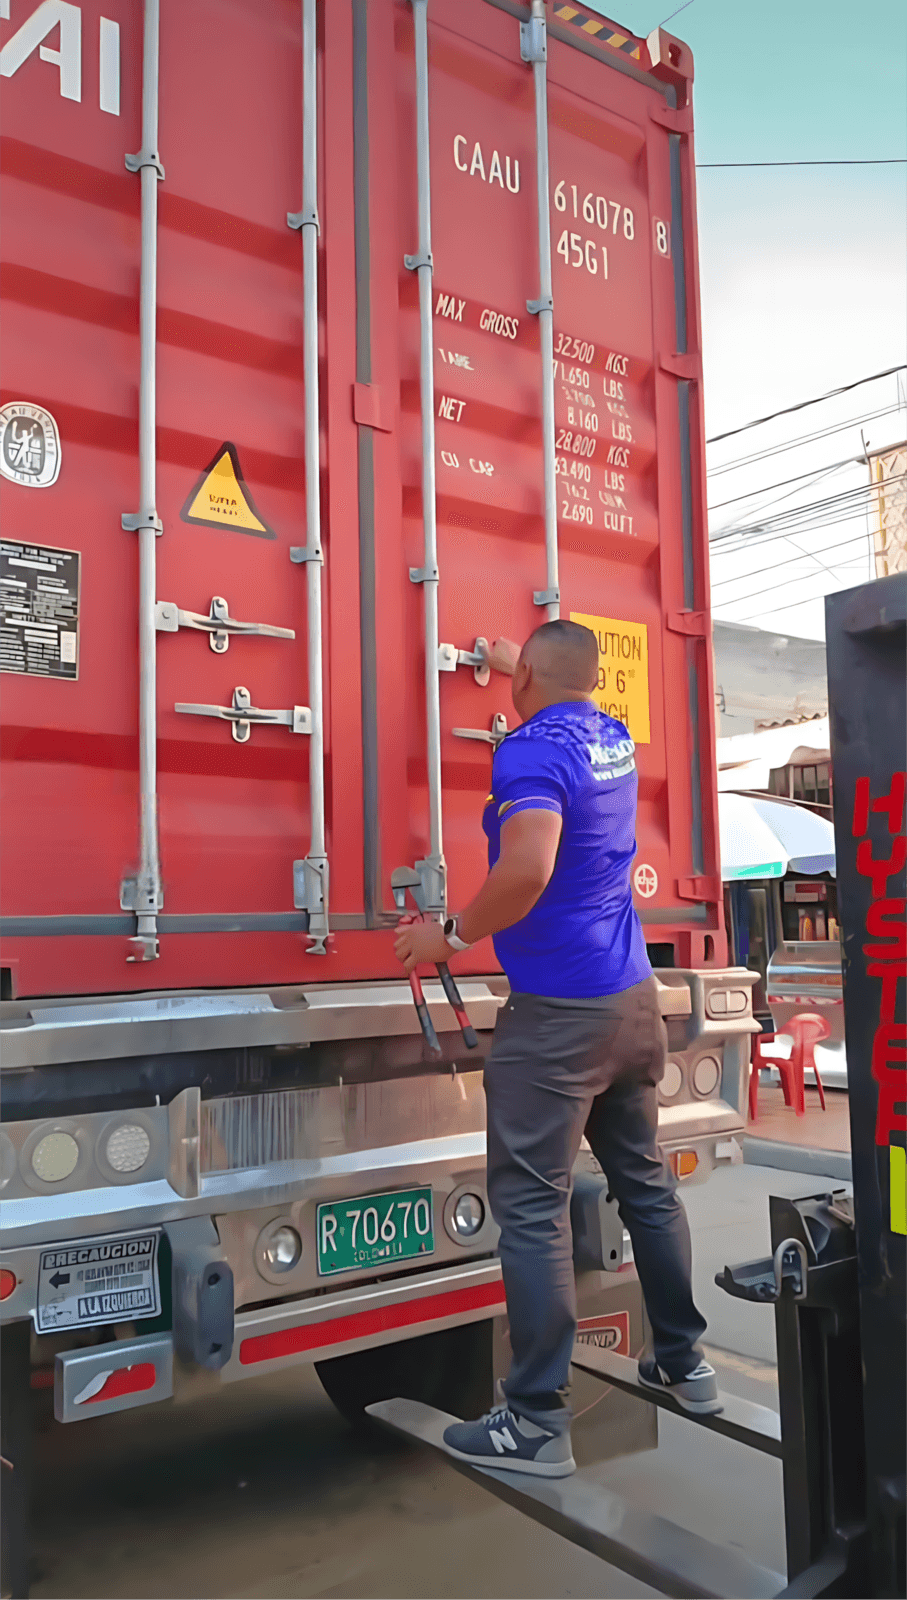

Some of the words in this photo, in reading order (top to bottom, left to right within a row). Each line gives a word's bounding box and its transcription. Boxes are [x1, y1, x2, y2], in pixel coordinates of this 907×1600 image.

[0, 0, 120, 116] AI
[453, 134, 520, 193] CAAU
[554, 180, 634, 240] 616078
[656, 220, 668, 254] 8
[557, 230, 609, 280] 45G1
[436, 293, 466, 322] MAX
[479, 308, 519, 340] GROSS
[438, 395, 467, 422] NET
[598, 631, 642, 661] UTION
[321, 1213, 338, 1255] R
[345, 1197, 431, 1249] 70670
[45, 1241, 150, 1268] PRECAUCION
[489, 1427, 518, 1454] N
